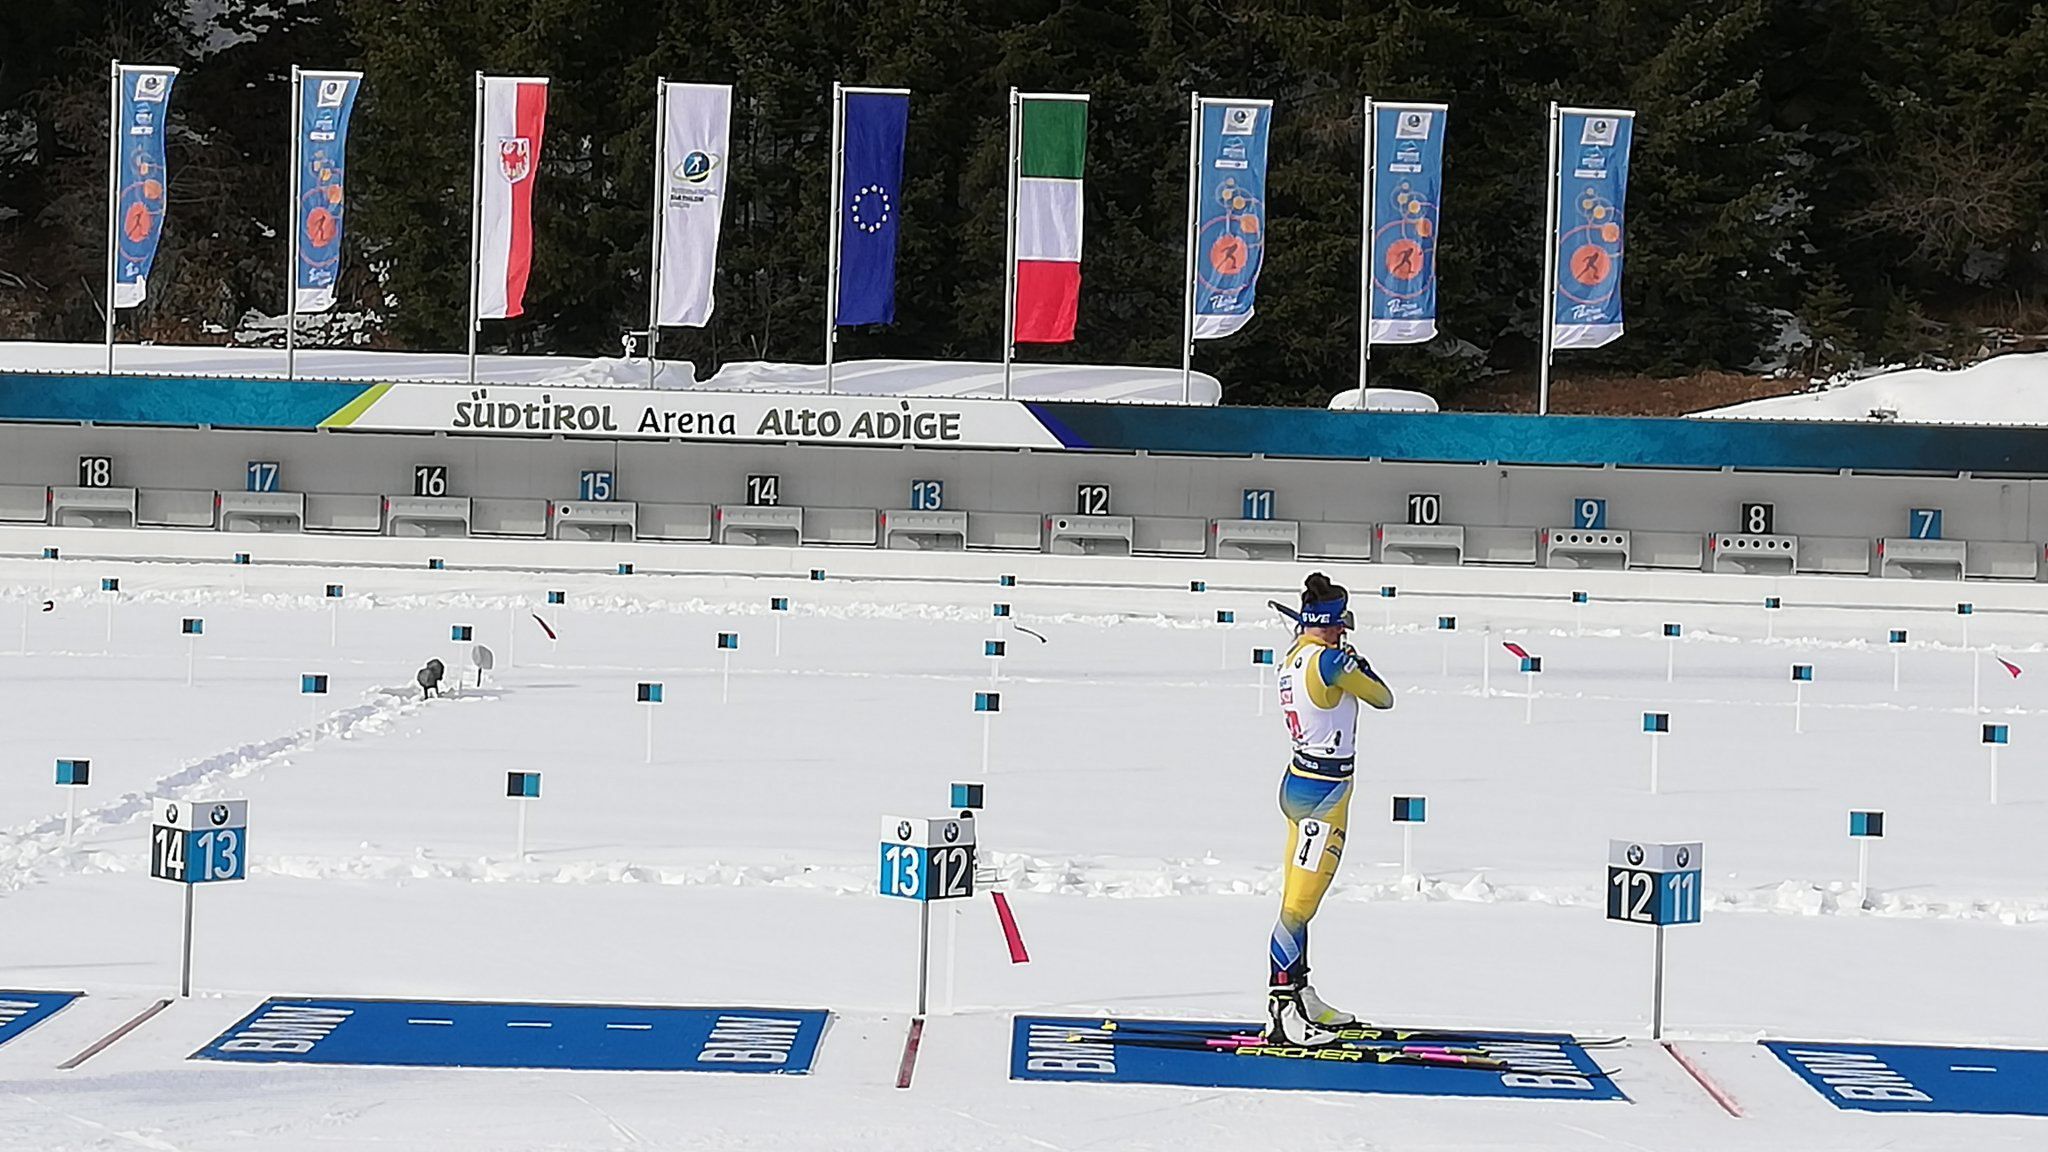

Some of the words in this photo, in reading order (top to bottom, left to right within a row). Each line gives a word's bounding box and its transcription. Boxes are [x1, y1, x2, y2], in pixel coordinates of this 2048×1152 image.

[637, 407, 736, 436] Arena
[81, 458, 110, 486] 18
[250, 463, 278, 492] 17
[416, 467, 445, 496] 16
[582, 472, 610, 501] 15
[749, 477, 778, 505] 14
[912, 482, 941, 510] 13
[1079, 487, 1107, 515] 12
[1246, 491, 1271, 519] 11
[1410, 496, 1438, 524] 10
[1581, 500, 1598, 529] 9
[1748, 505, 1766, 533] 8
[1917, 511, 1935, 538] 7
[155, 828, 184, 880] 14
[197, 830, 237, 879] 13
[1299, 838, 1312, 866] 4
[885, 846, 919, 896] 13
[933, 847, 968, 897] 12
[1613, 870, 1653, 922] 12
[1669, 872, 1694, 922] 11
[218, 1005, 355, 1053] BMW
[697, 1015, 801, 1063] BMW
[1027, 1023, 1116, 1073] BMW
[1235, 1046, 1363, 1062] FISCHER
[1787, 1048, 1934, 1102] BMW
